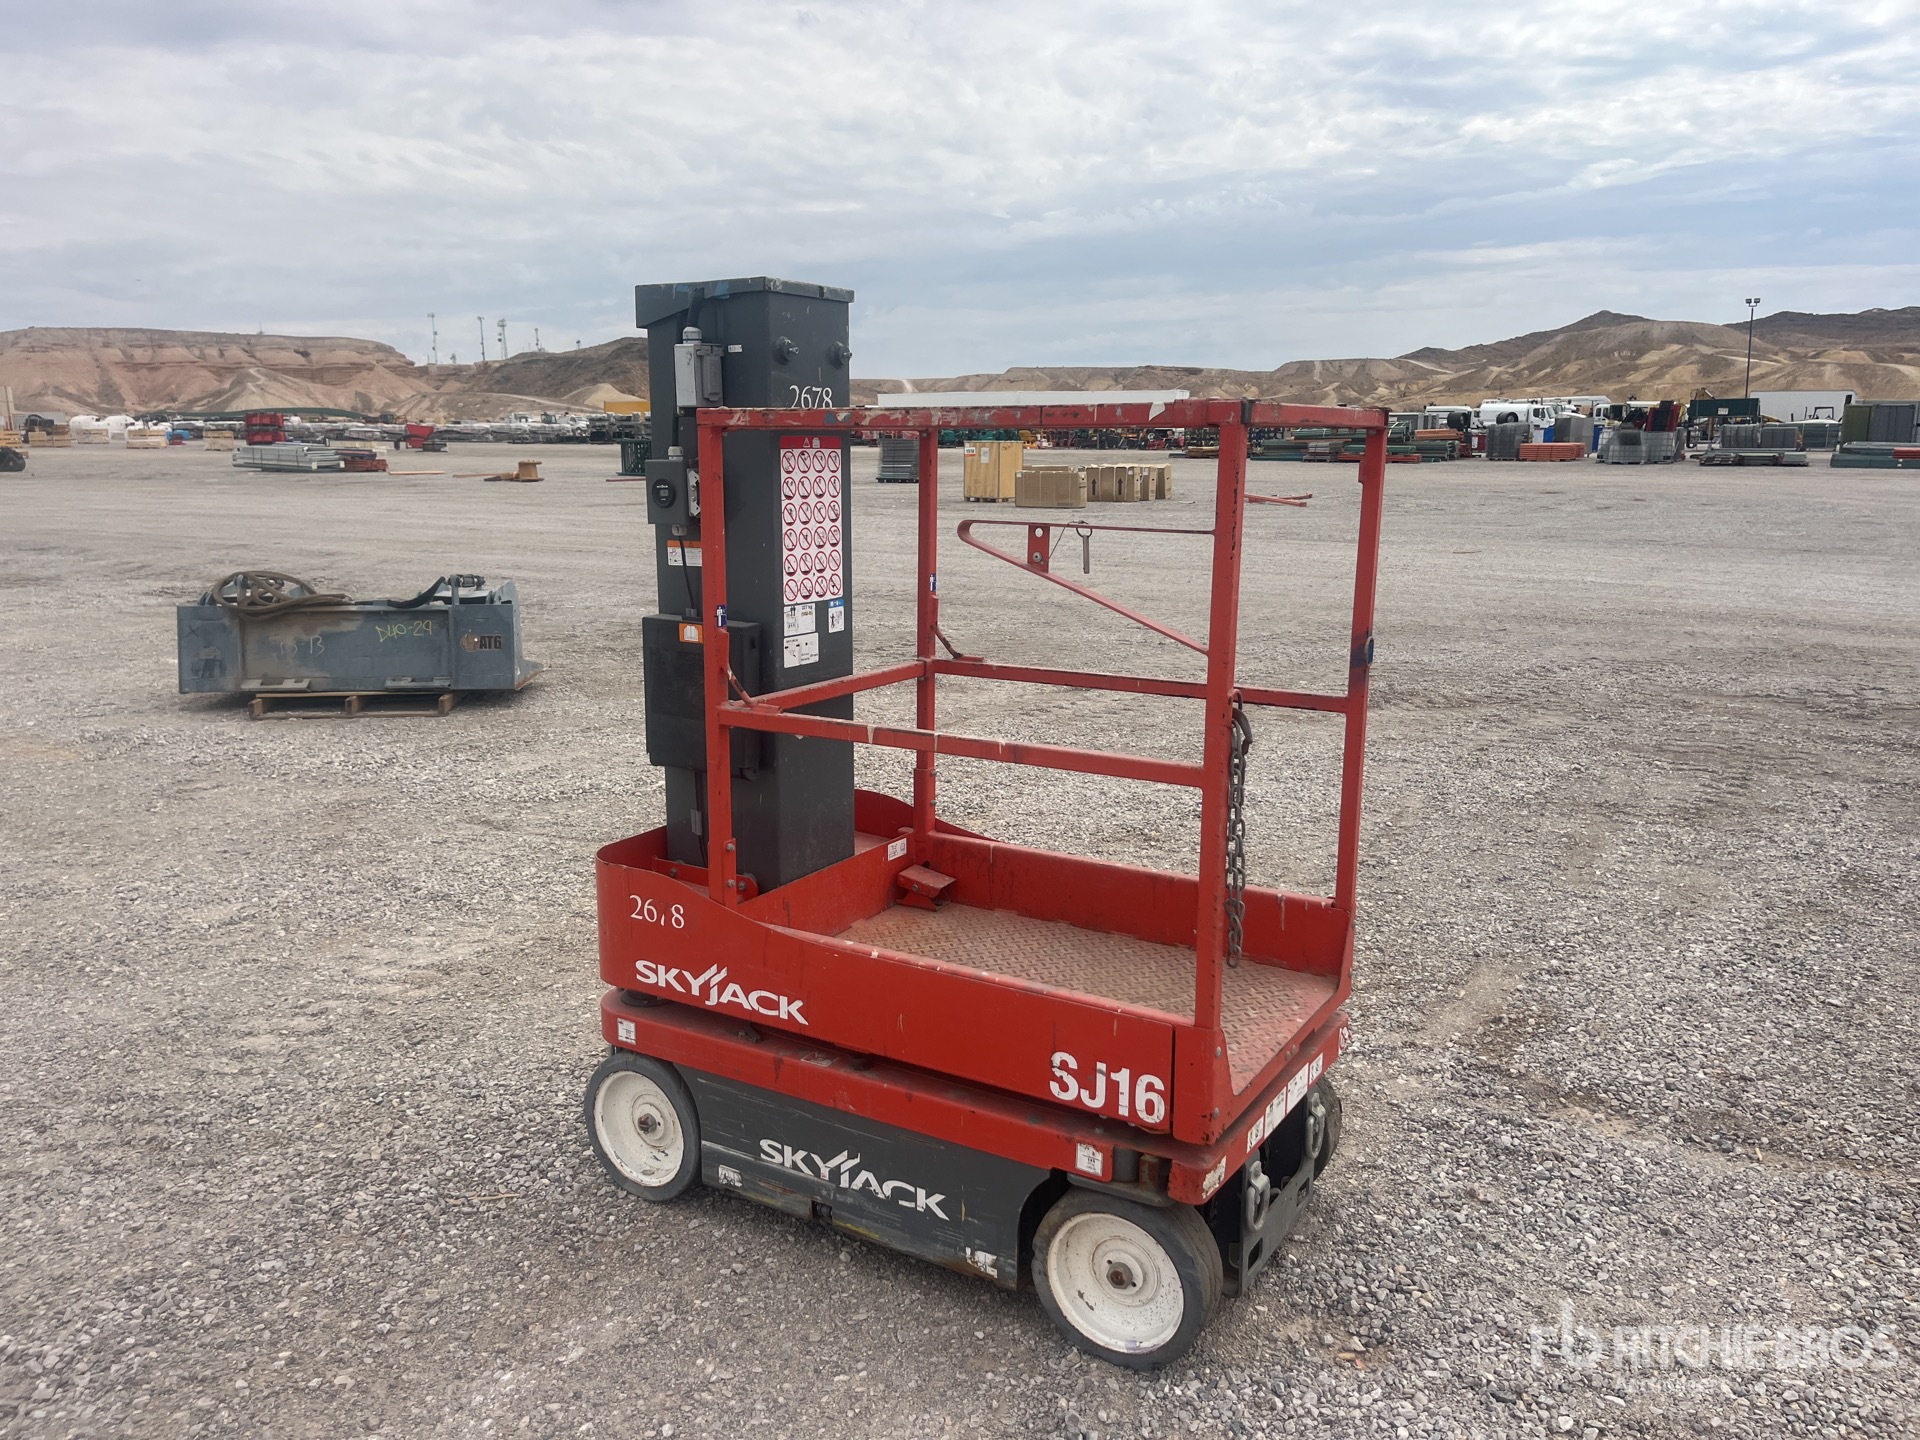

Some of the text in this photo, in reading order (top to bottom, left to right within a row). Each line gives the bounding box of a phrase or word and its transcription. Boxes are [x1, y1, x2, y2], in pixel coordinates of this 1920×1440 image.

[789, 385, 833, 409] 2678
[635, 959, 809, 1026] SKYJACK
[1049, 1051, 1166, 1124] SJ16
[759, 1138, 950, 1221] SKYJACK
